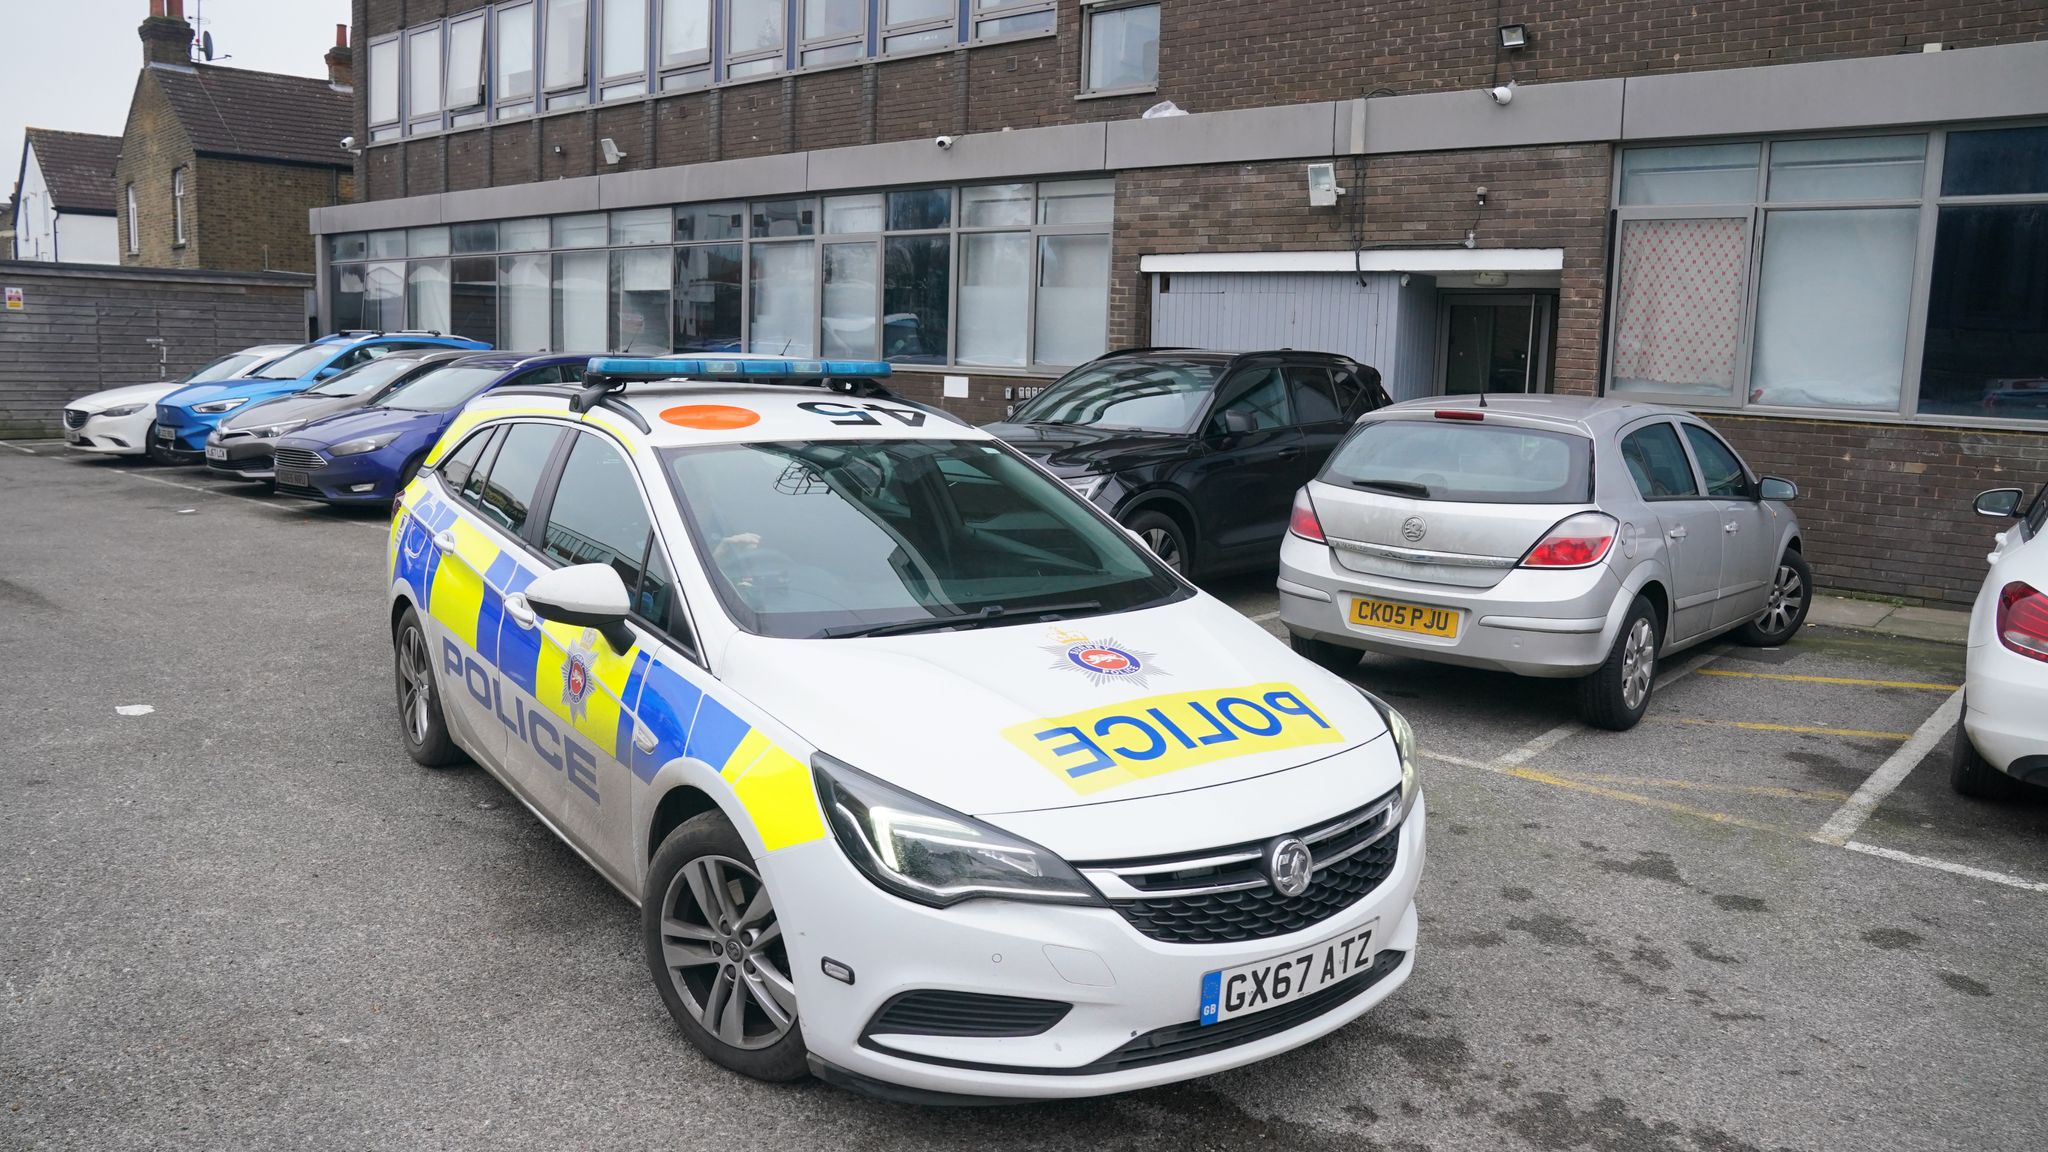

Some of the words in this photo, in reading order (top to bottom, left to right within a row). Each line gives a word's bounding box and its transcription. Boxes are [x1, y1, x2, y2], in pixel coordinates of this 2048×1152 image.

[1357, 601, 1407, 625] CK05
[1410, 607, 1450, 631] PJU
[1101, 664, 1139, 675] POLICE
[442, 635, 601, 806] POLICE
[1225, 953, 1314, 1012] GX67
[1320, 929, 1372, 984] ATZ
[1203, 1003, 1217, 1016] GB
